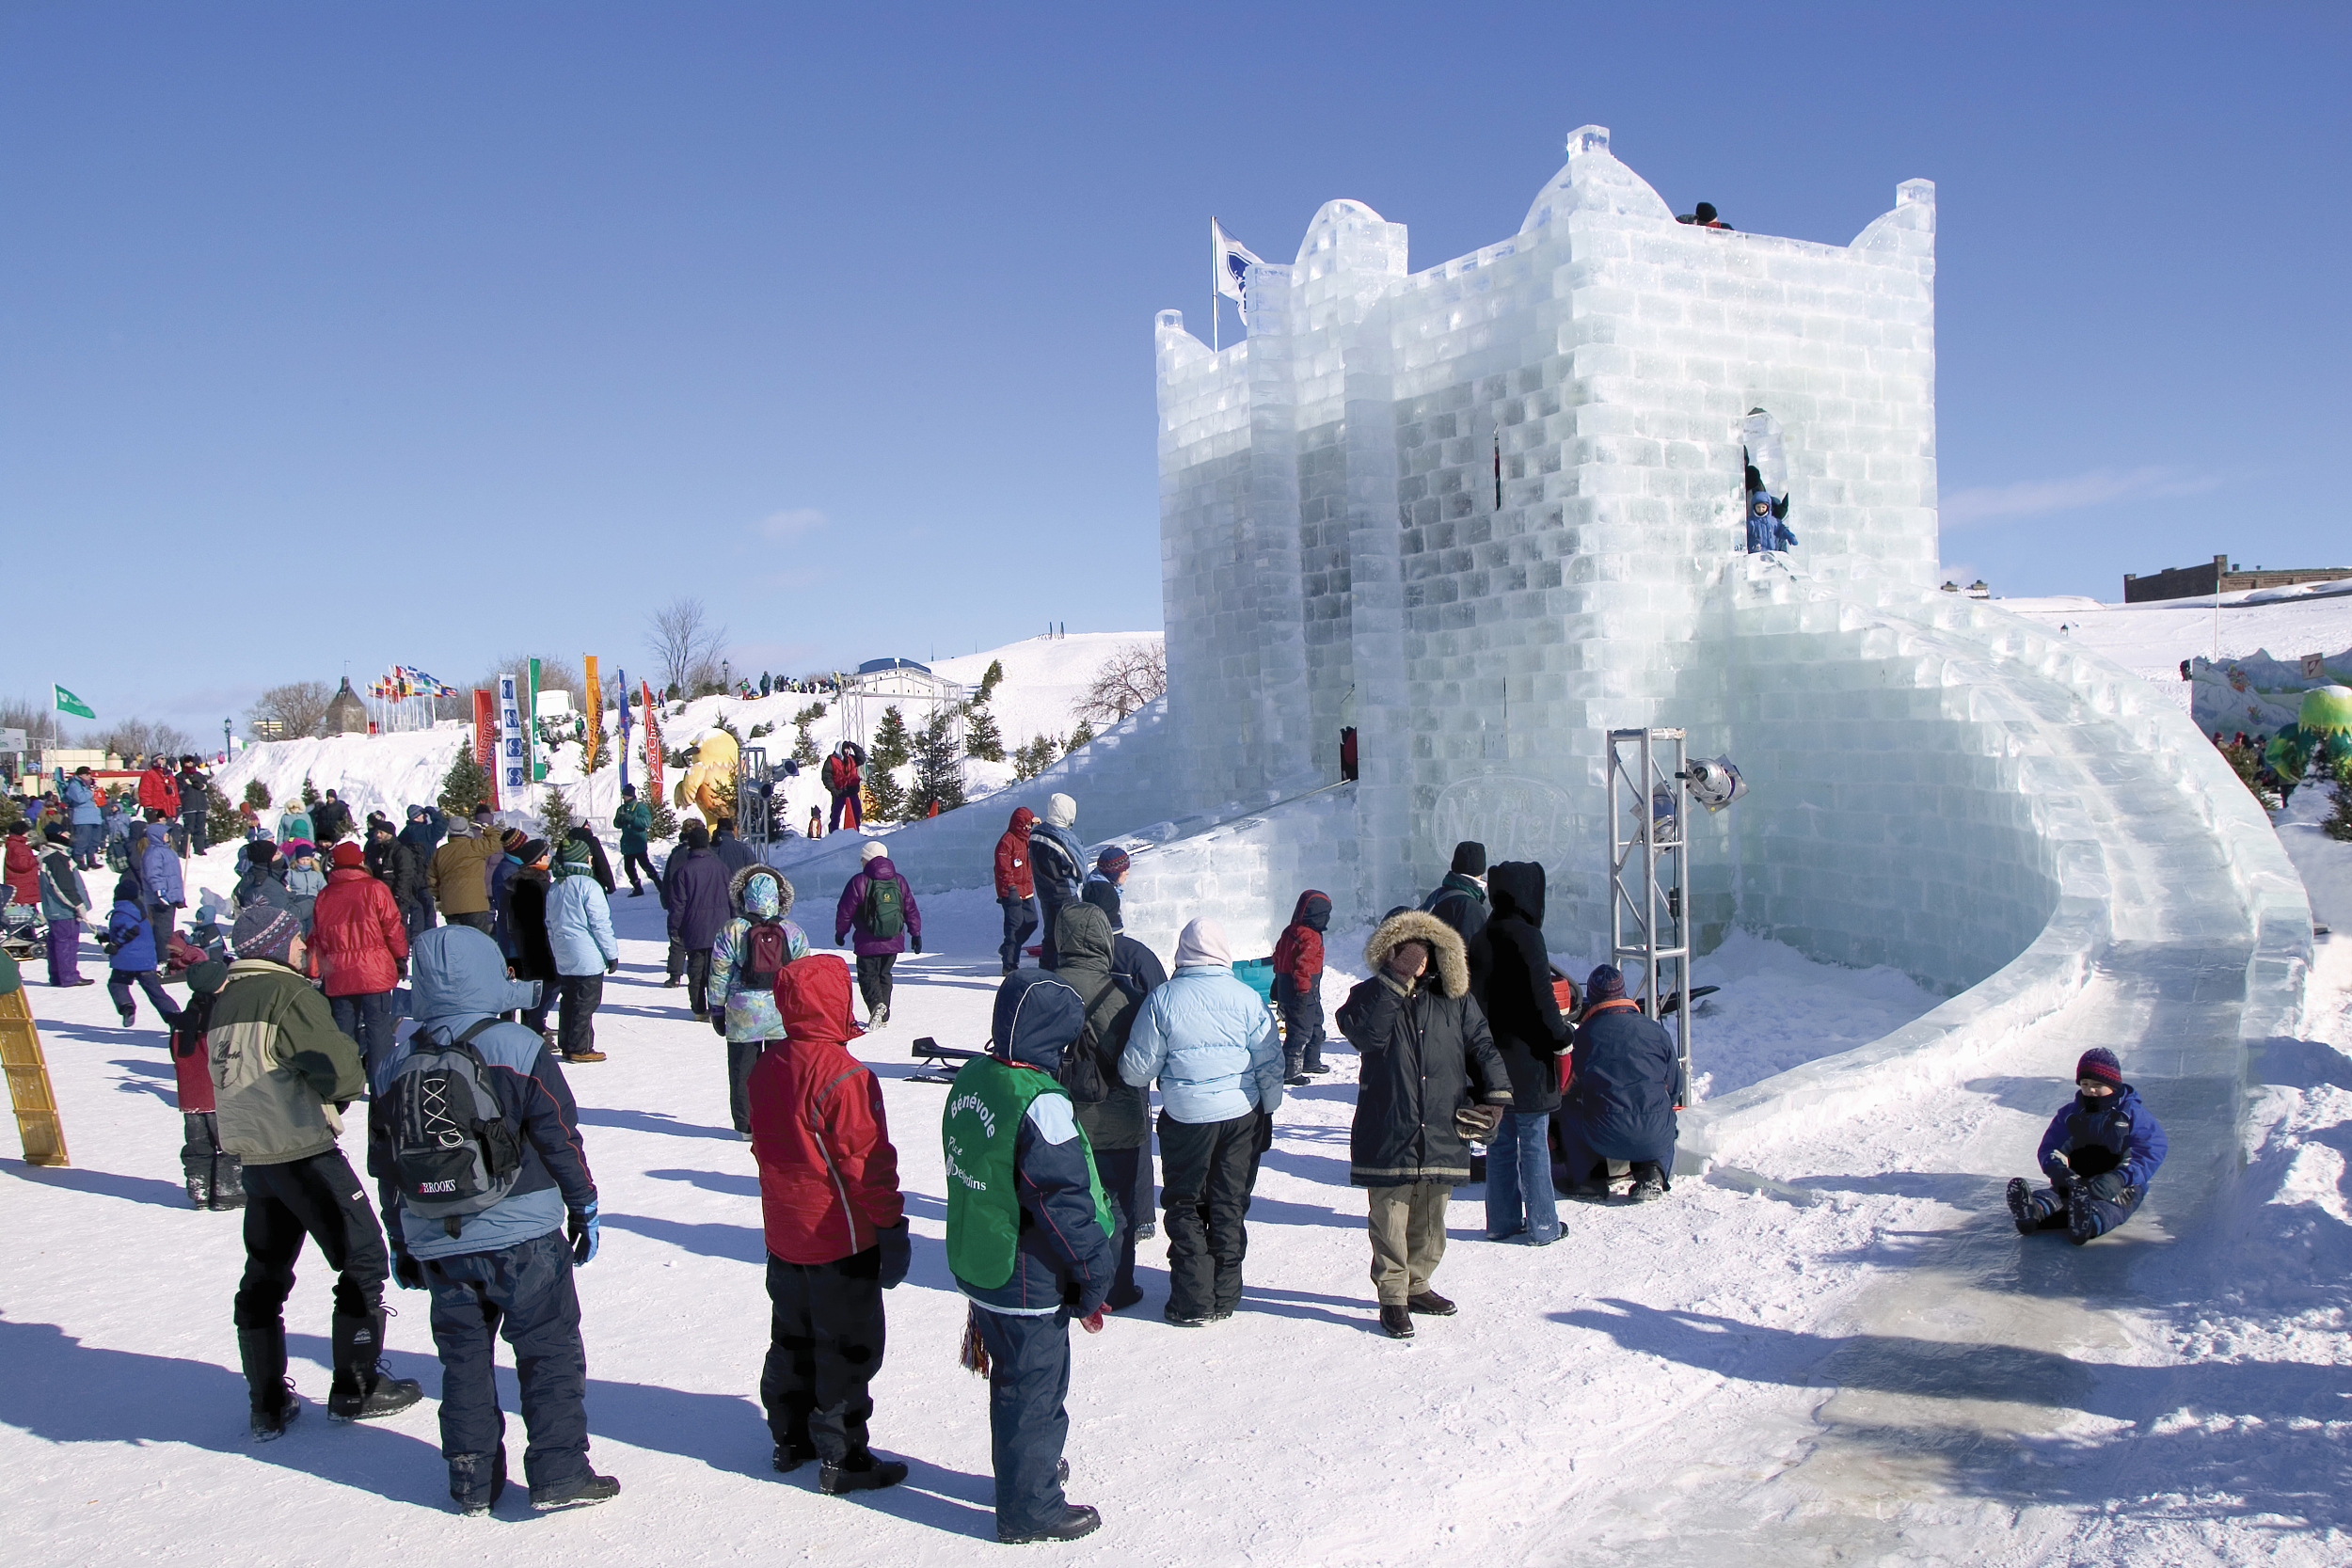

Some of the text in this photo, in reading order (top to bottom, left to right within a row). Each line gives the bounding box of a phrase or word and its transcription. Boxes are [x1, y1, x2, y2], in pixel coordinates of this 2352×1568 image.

[950, 1091, 995, 1138] Bénévole
[421, 1179, 456, 1193] BROOKS
[951, 1163, 987, 1191] Dejdins
